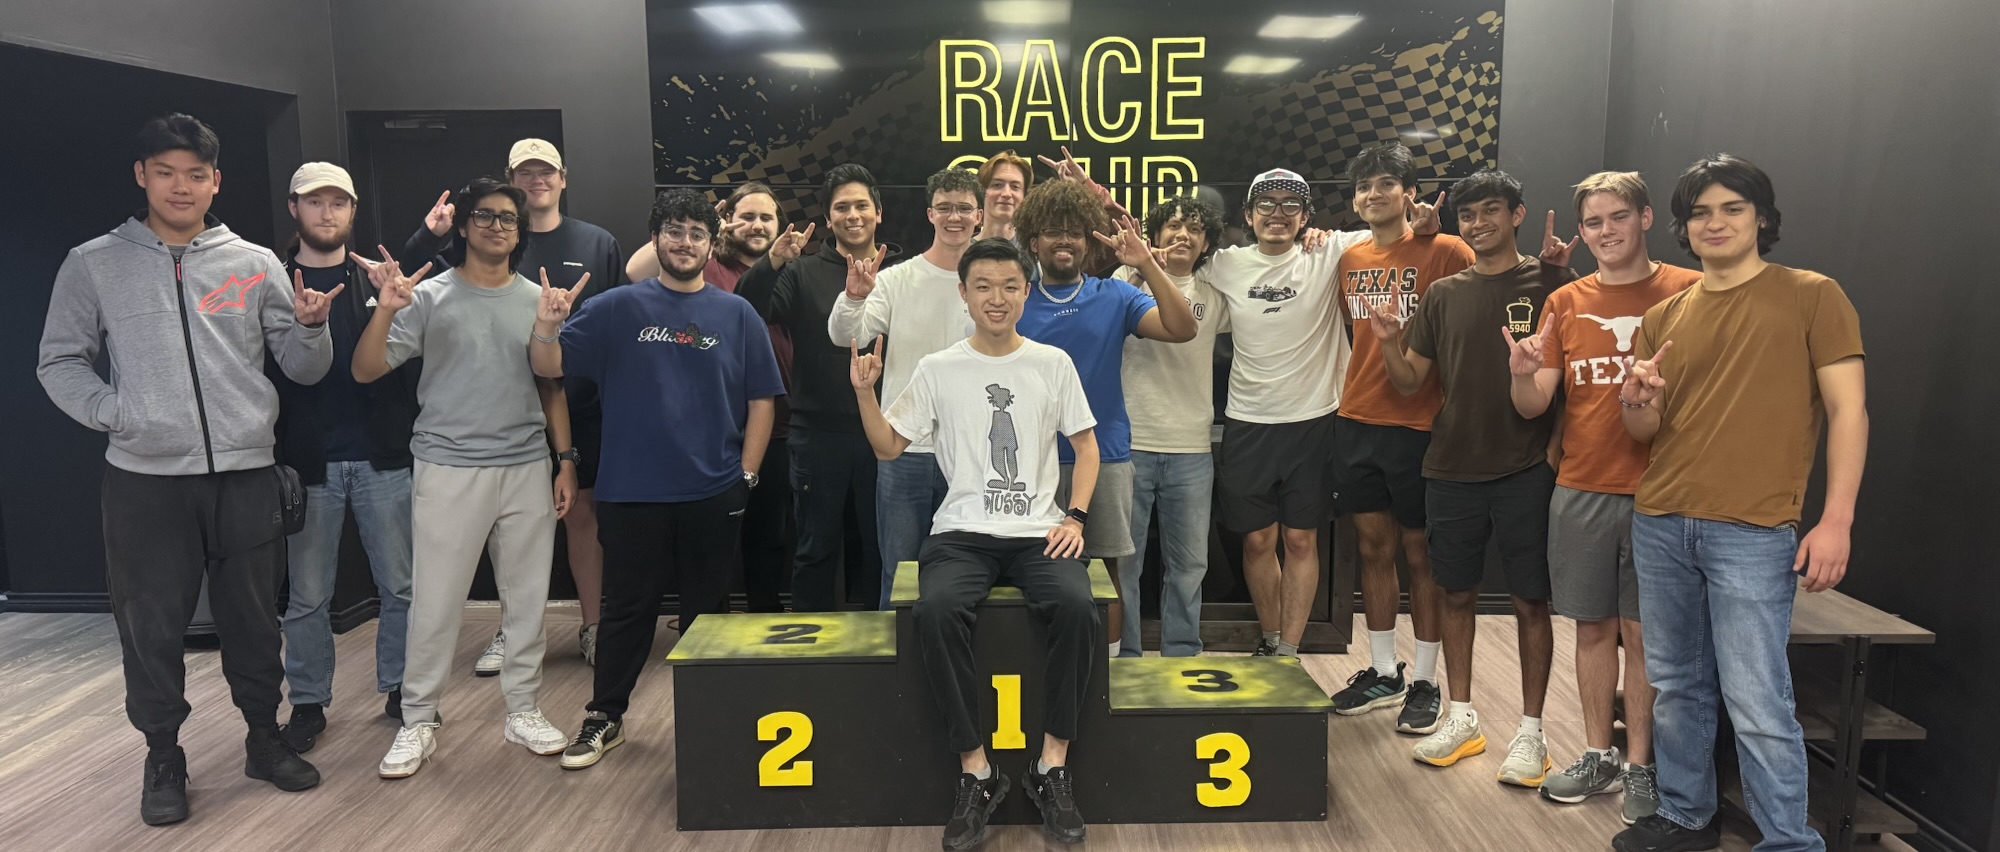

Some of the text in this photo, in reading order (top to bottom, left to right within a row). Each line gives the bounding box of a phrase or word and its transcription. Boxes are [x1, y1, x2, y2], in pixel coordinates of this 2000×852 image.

[939, 36, 1206, 143] RACE
[1346, 267, 1418, 295] TEXAS
[1509, 323, 1531, 333] 5940
[764, 623, 823, 645] 2
[1181, 669, 1239, 693] 3
[991, 674, 1026, 750] 1
[757, 711, 814, 787] 2
[1195, 732, 1252, 808] 3
